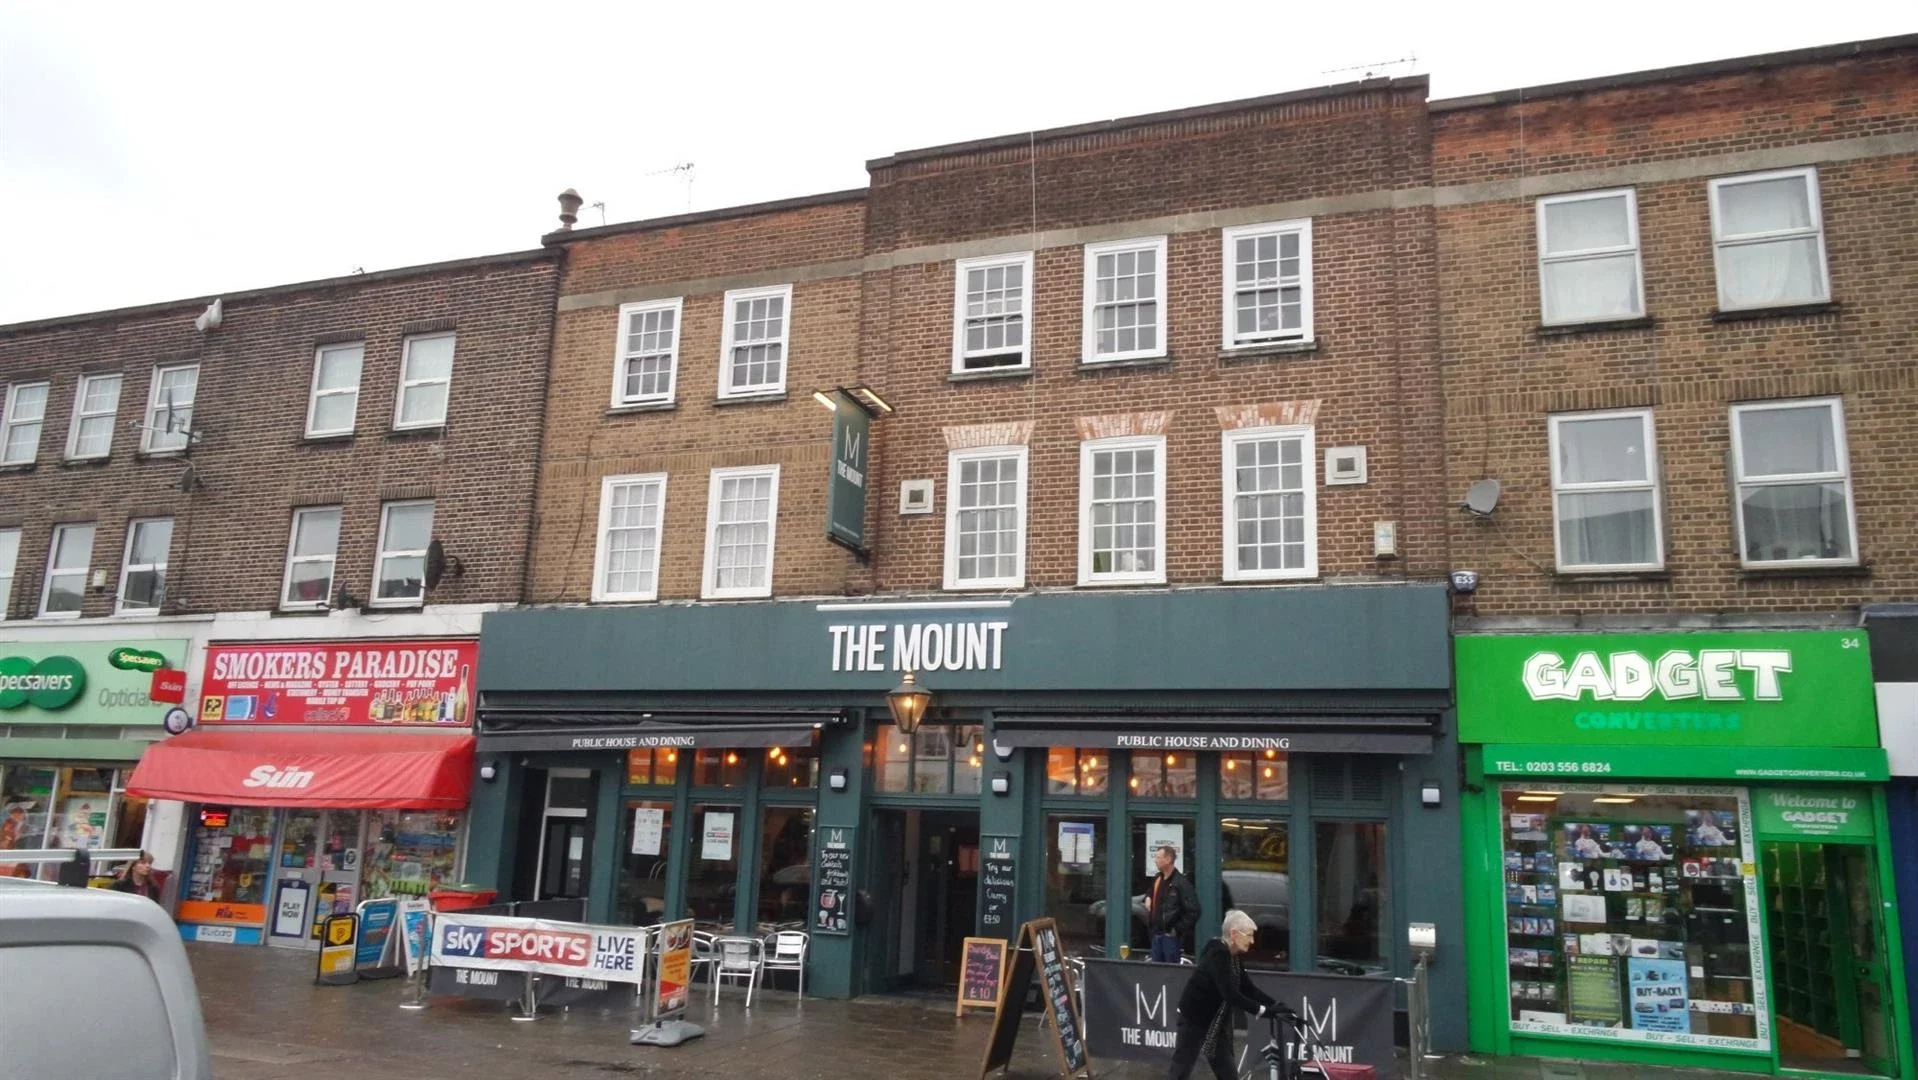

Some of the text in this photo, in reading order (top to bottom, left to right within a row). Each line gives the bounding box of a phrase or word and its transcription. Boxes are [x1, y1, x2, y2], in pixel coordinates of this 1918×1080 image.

[844, 425, 860, 468] M
[837, 459, 863, 488] THE MOUNT
[829, 621, 1009, 672] THE MOUNT
[1841, 637, 1860, 649] 34
[119, 651, 163, 667] Specsavers
[213, 648, 458, 680] SMOKERS PARADISE
[1522, 648, 1793, 702] GADGET
[1574, 711, 1742, 733] CONVERTERS
[572, 736, 695, 748] PUBLIC HOUSE AND DINING
[1117, 735, 1290, 749] PUBLIC HOUSE AND DINING
[1496, 761, 1611, 773] TEL: 0203 556 6824
[1769, 793, 1857, 810] Welcome to
[1781, 810, 1849, 824] GADGET
[993, 837, 1006, 852] M
[985, 862, 999, 874] Try
[281, 911, 300, 919] NOW
[446, 926, 588, 961] sky SPORTS
[597, 936, 635, 955] LIVE
[595, 954, 634, 971] HERE
[456, 969, 498, 985] THE MOUNT
[565, 976, 608, 991] THE MOUNT
[1135, 983, 1167, 1027] M
[1302, 995, 1337, 1042] M
[1121, 1027, 1177, 1048] THE MOUN
[1512, 1022, 1619, 1037] BUY SELL EXCHANGE
[1646, 1032, 1759, 1049] BUY SELL EXCHANGE
